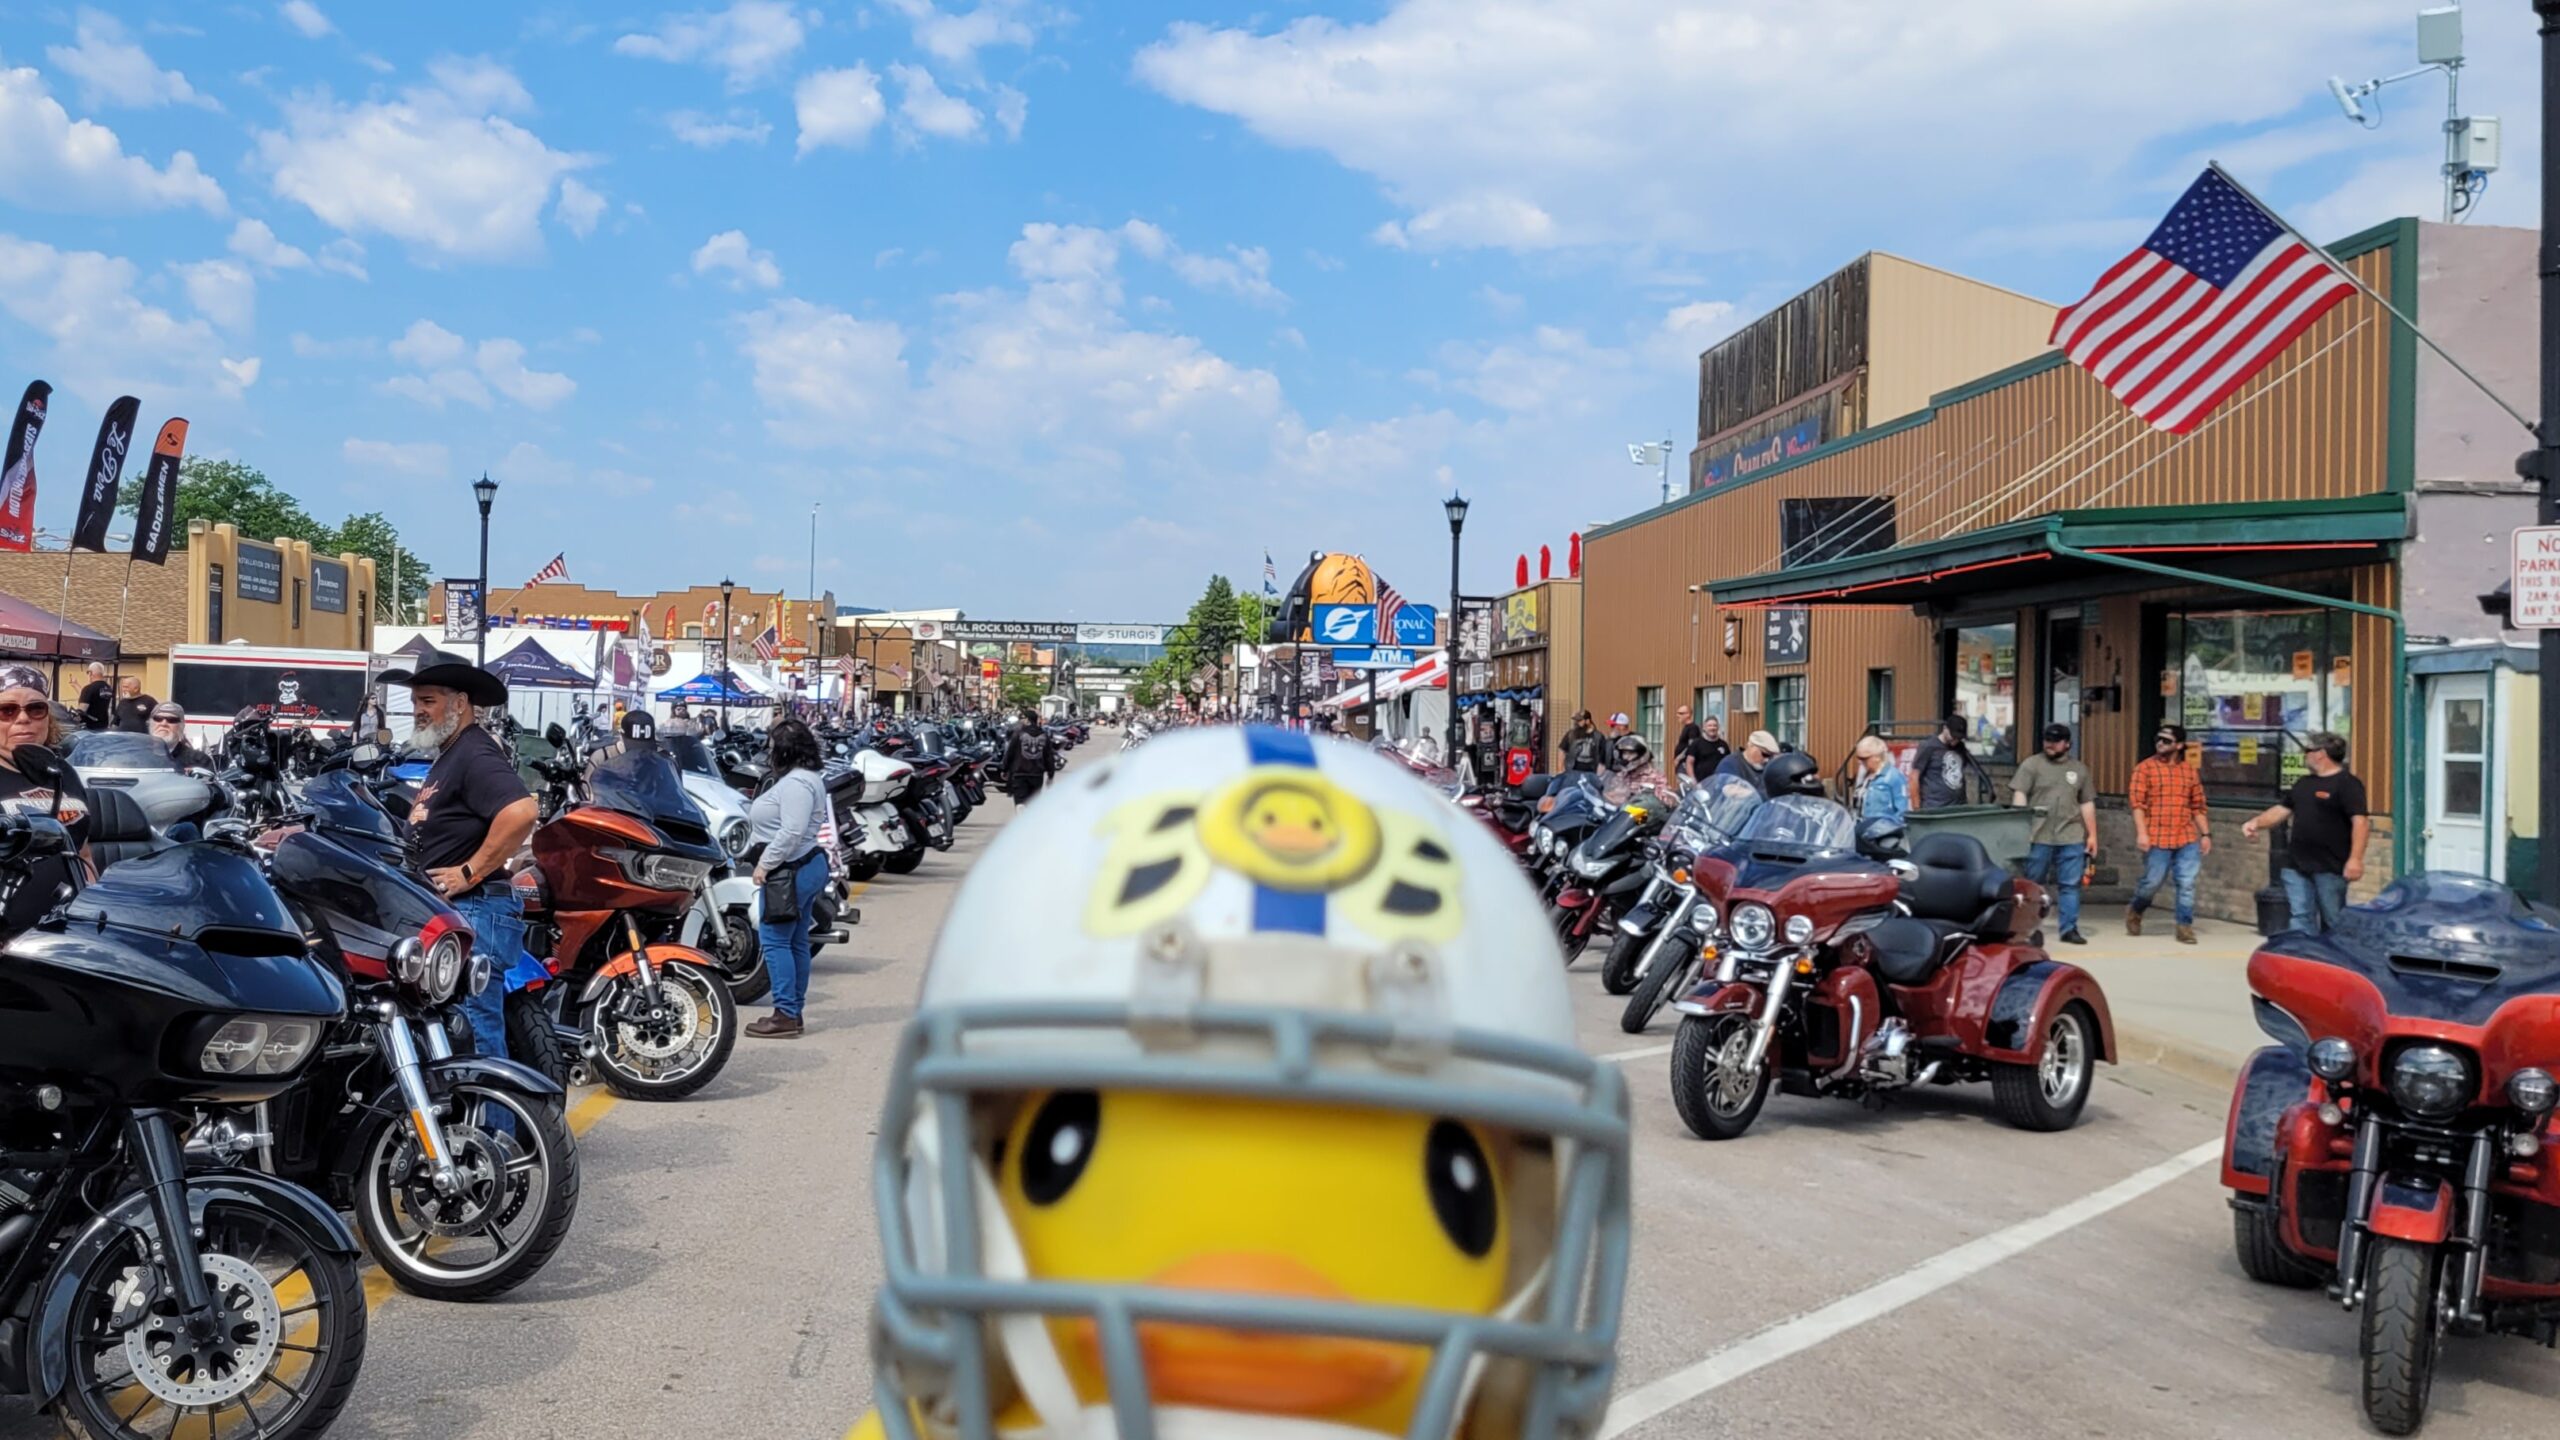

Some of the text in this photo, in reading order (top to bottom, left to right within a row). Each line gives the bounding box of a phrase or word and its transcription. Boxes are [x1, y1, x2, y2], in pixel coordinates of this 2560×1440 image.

[107, 421, 126, 456] Le
[146, 461, 169, 553] SADDLEMEN
[2520, 577, 2543, 587] THIS
[448, 590, 461, 639] STURGIS
[2523, 605, 2543, 616] ANY
[943, 623, 1076, 634] REAL ROCK 100.3 THE FOX
[1107, 629, 1157, 640] STURGIS
[655, 654, 666, 666] R
[1369, 648, 1402, 663] ATM
[632, 724, 652, 739] H-D
